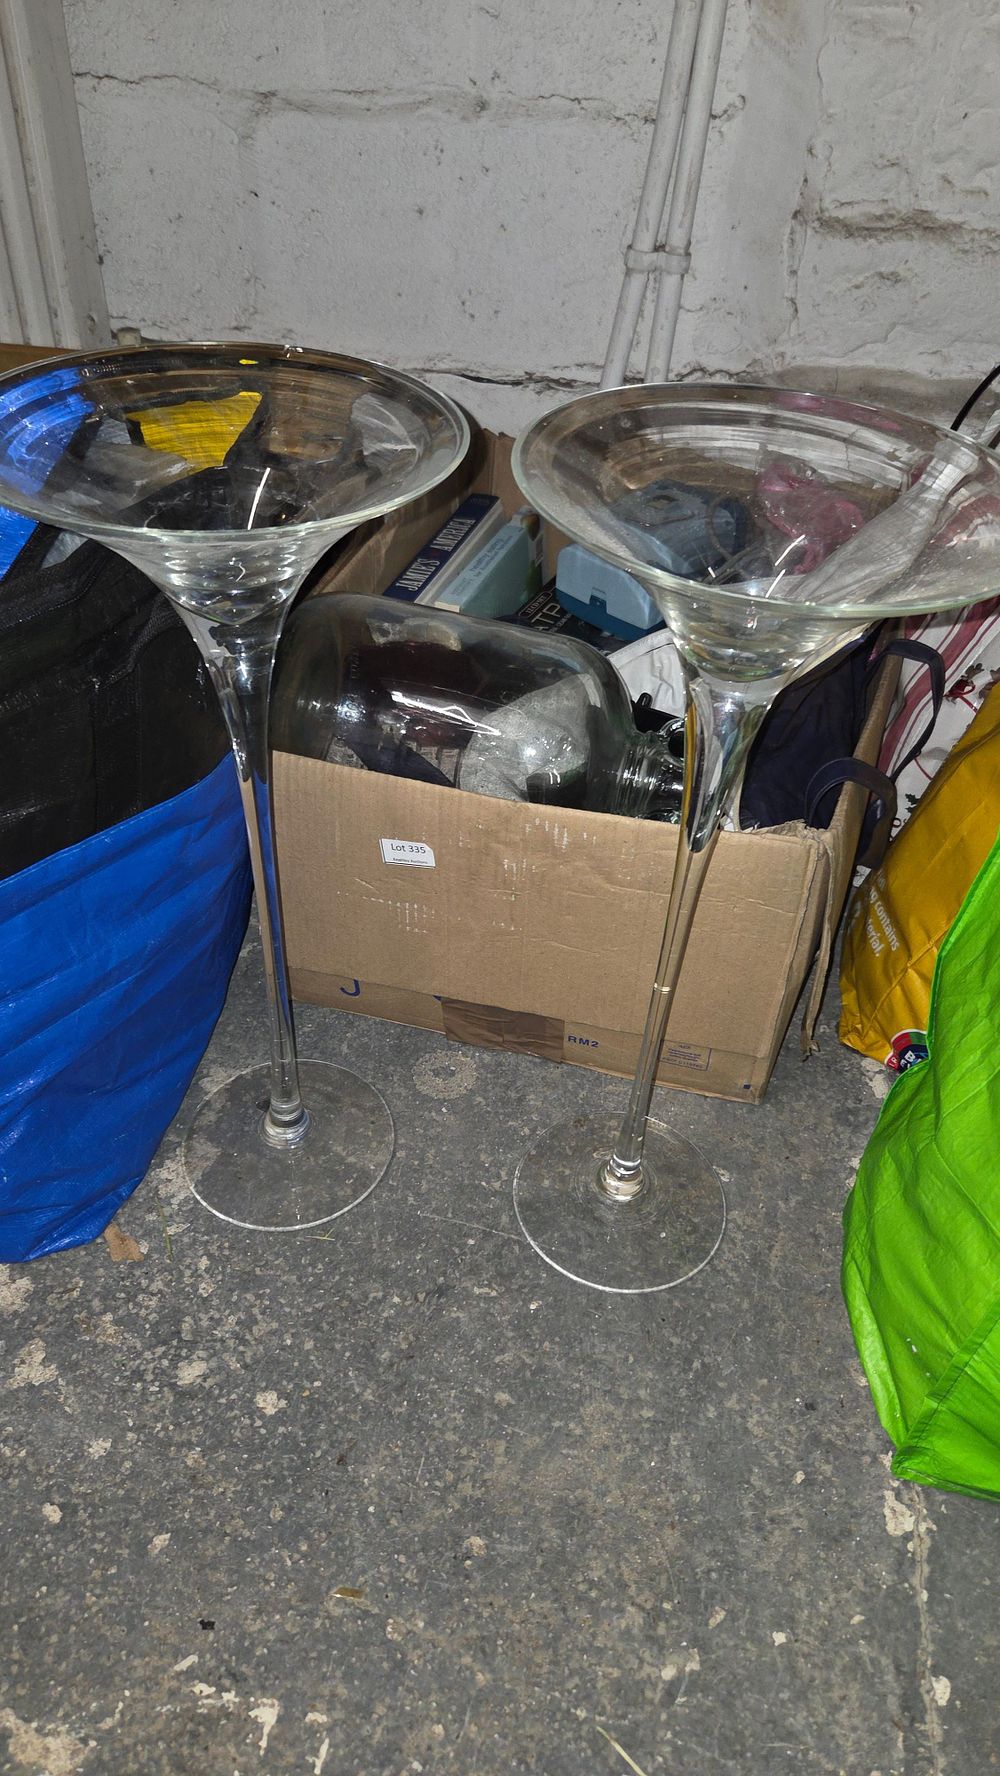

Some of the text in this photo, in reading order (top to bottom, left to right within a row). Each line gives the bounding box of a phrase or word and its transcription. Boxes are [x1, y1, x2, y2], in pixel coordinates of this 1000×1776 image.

[395, 558, 440, 592] JAMIE'S
[430, 518, 477, 552] AMERICA
[390, 843, 426, 854] Lot 335
[874, 901, 900, 951] contains
[567, 1035, 599, 1048] RM2
